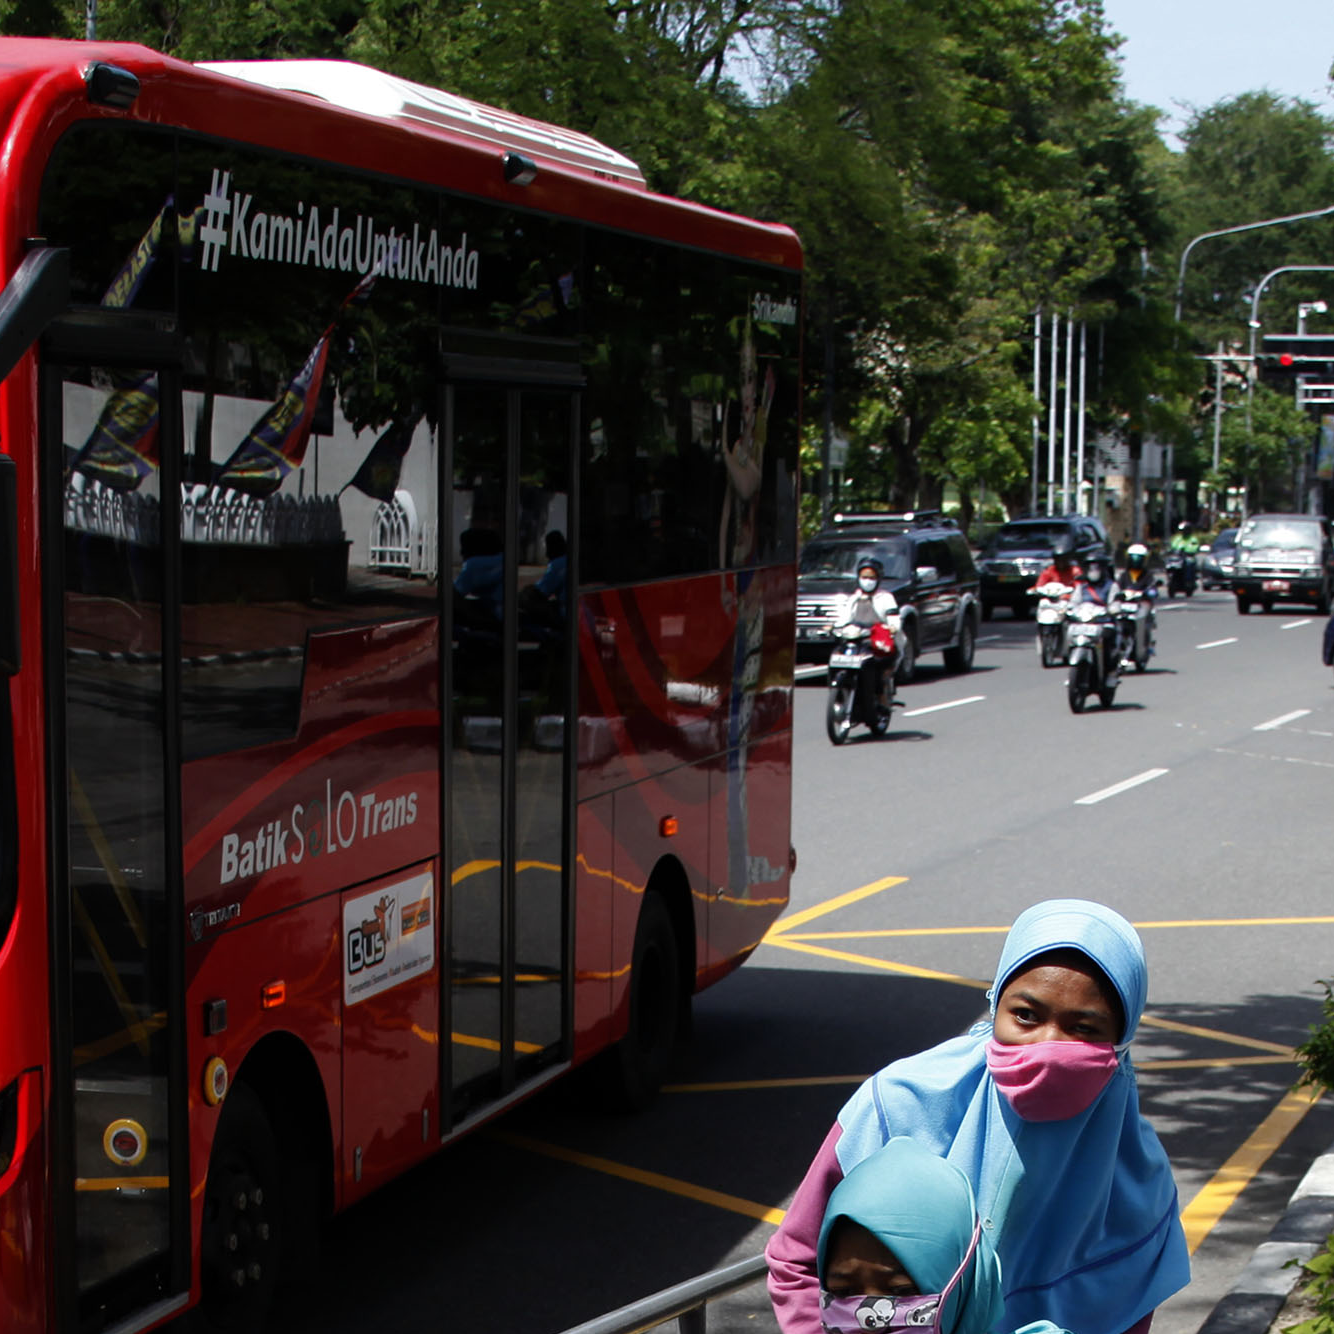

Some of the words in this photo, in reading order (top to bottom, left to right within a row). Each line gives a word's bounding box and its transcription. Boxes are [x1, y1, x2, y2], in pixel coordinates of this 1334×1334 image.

[199, 167, 479, 290] #KamiAdaUntukAnda
[219, 819, 289, 885] Batik
[360, 791, 419, 839] Trans
